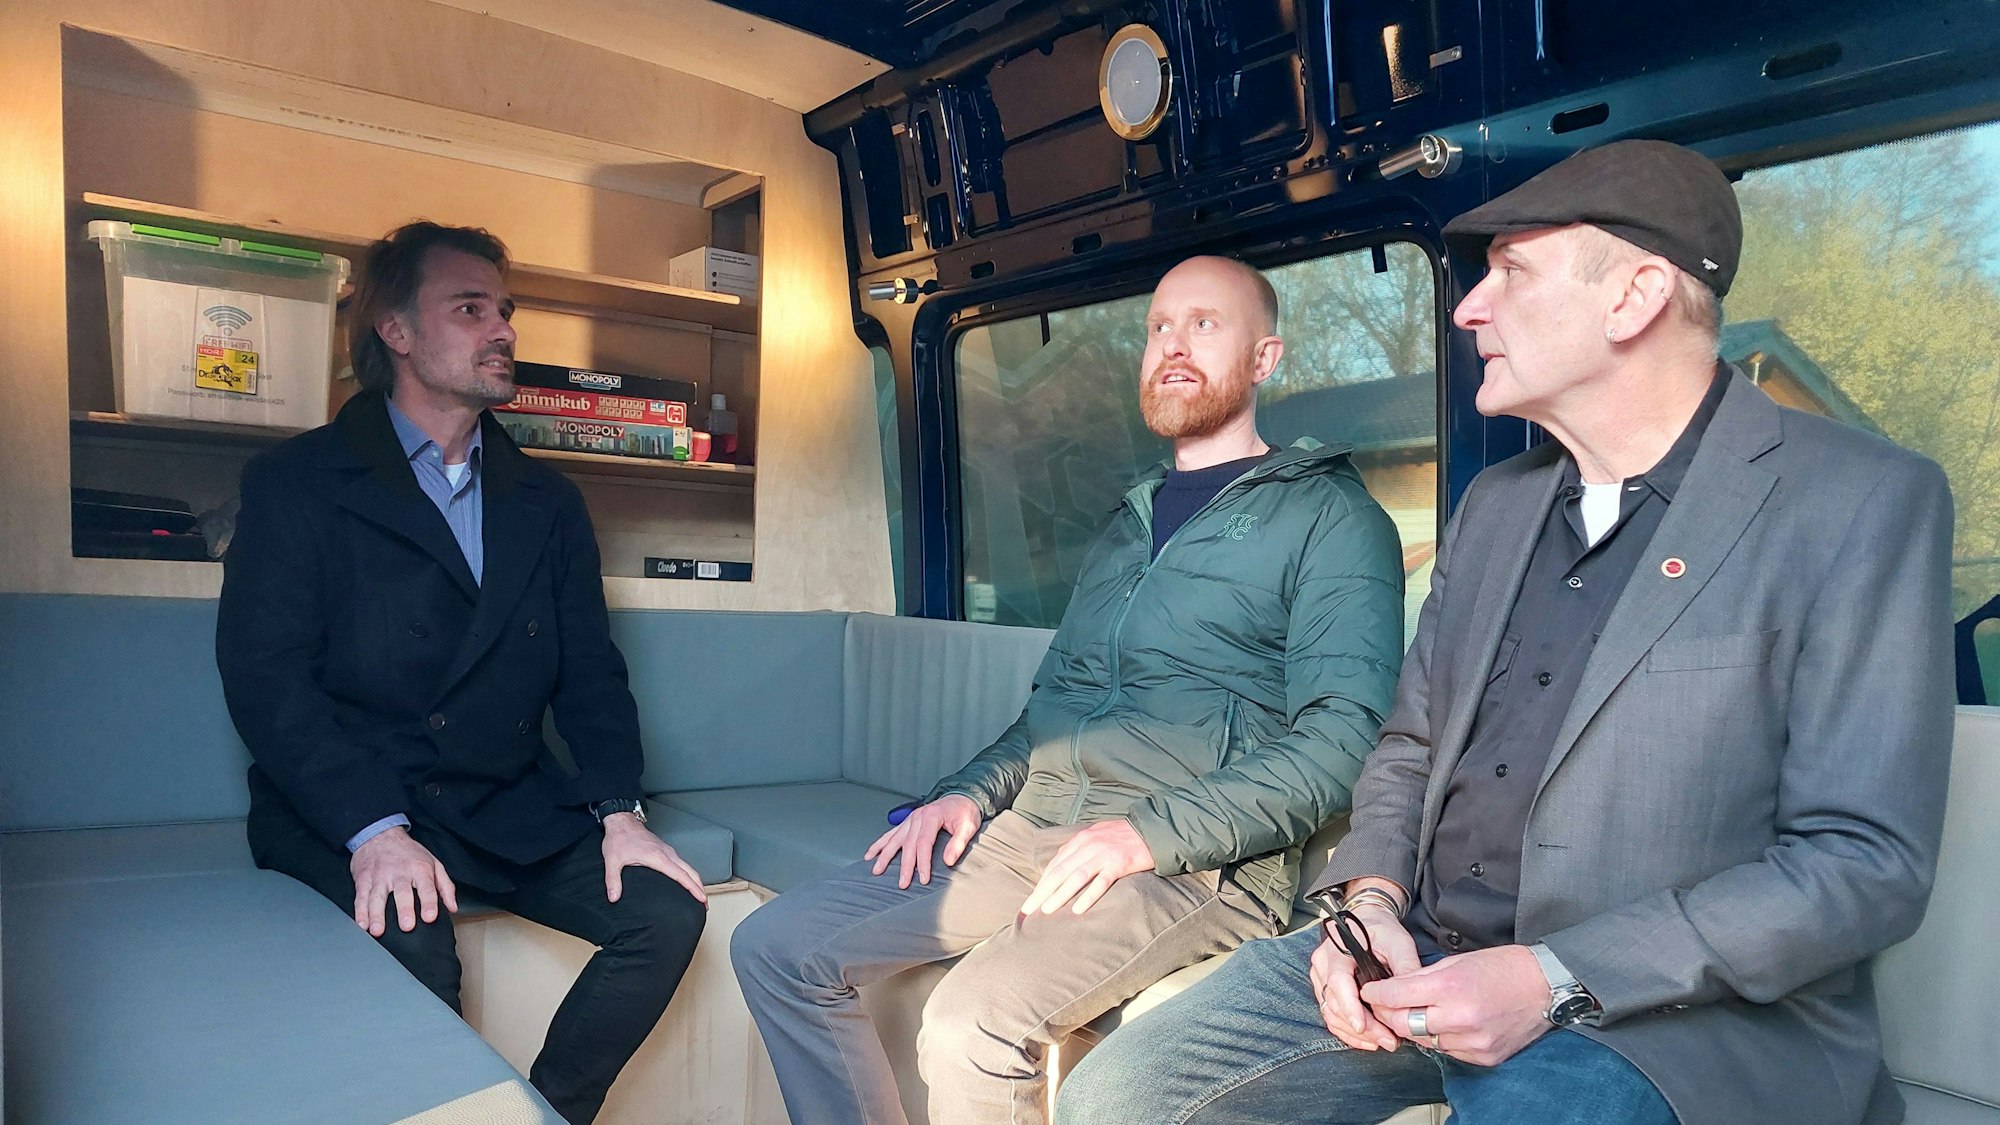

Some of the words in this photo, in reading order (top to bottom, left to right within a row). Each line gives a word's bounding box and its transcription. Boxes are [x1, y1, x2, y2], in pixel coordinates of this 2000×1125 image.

[241, 354, 255, 364] 24
[571, 373, 619, 386] MONOPOLY
[507, 393, 591, 411] ummikub
[556, 421, 625, 438] MONOPOLY
